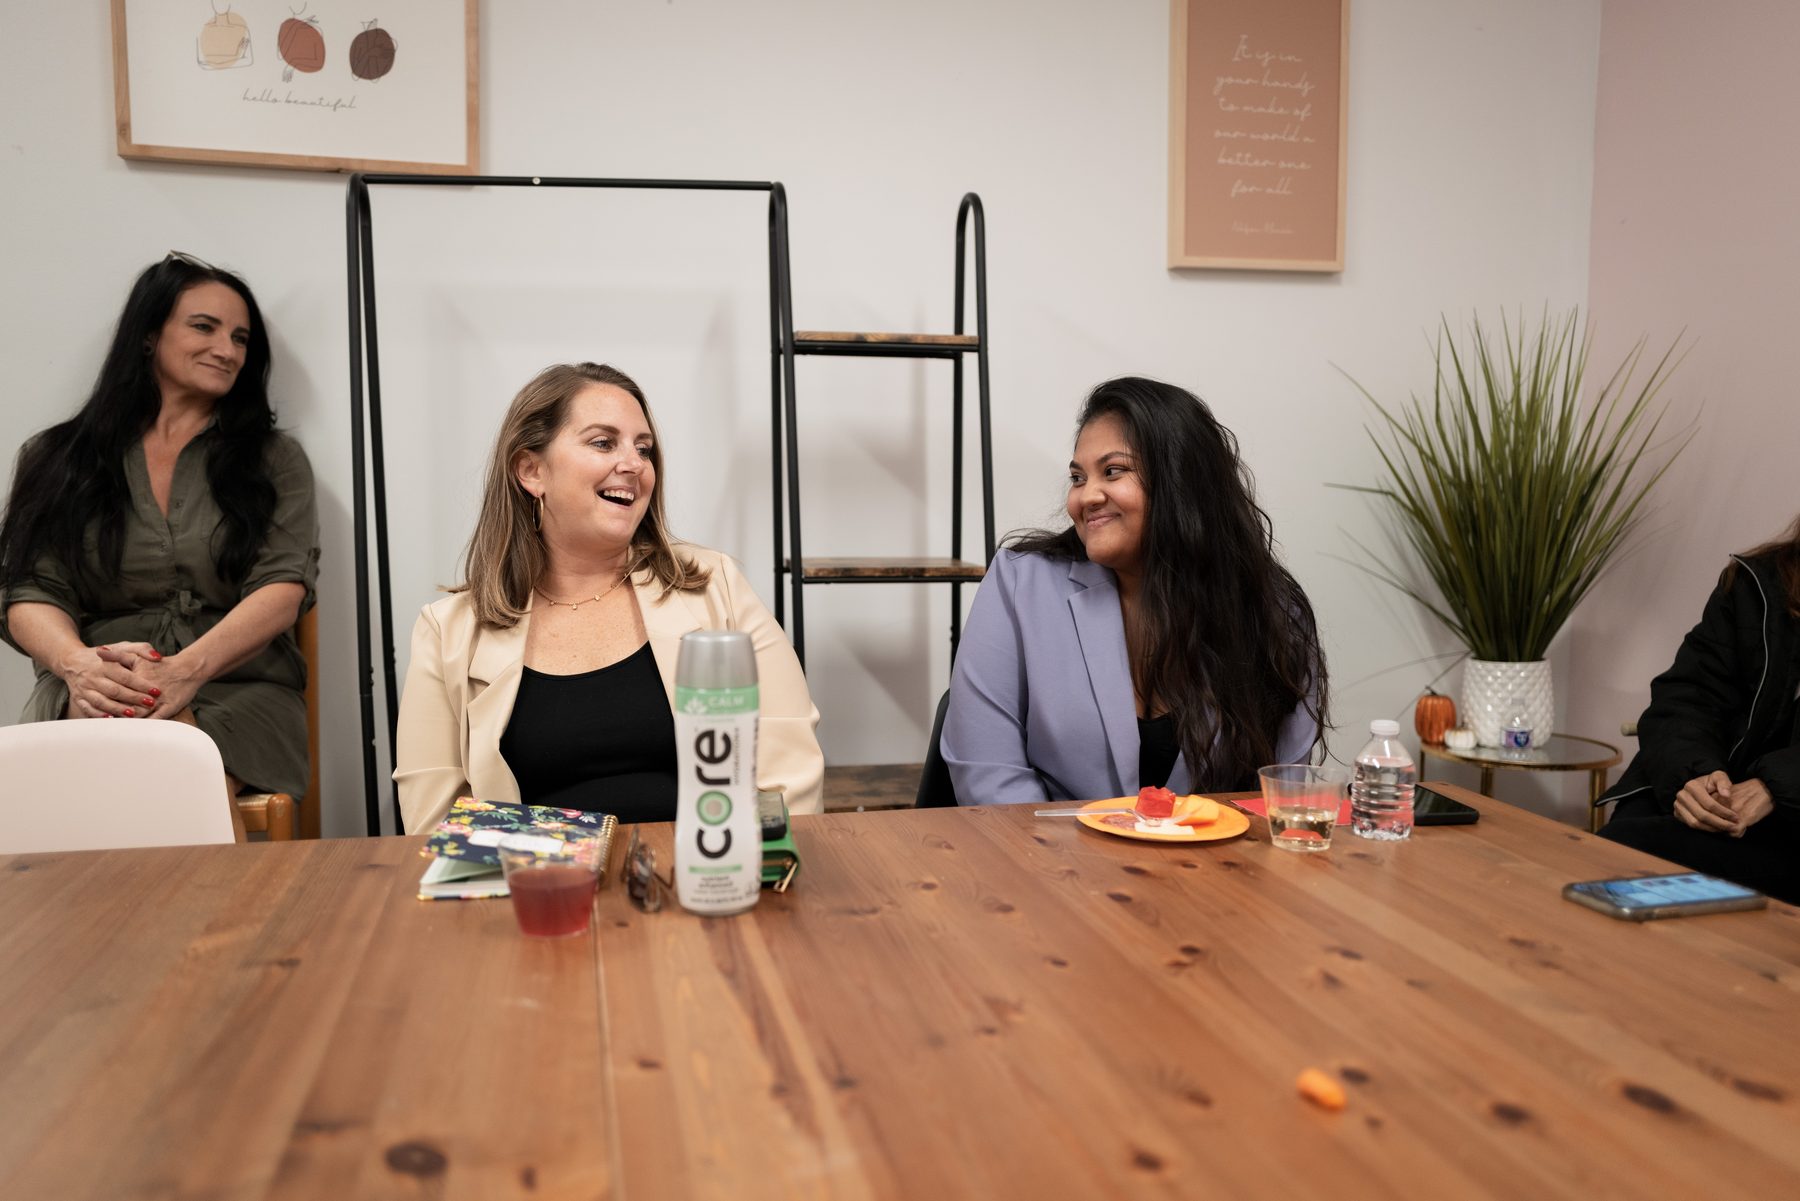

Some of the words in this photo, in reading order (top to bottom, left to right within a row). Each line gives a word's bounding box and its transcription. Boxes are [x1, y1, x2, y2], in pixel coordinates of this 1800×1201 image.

[1232, 34, 1252, 61] It
[1279, 53, 1302, 62] in
[1213, 76, 1259, 95] your
[1262, 69, 1315, 97] hands
[242, 88, 280, 103] hello
[284, 91, 356, 112] beautiful
[1219, 98, 1240, 112] to
[1242, 96, 1290, 114] make
[1293, 103, 1312, 121] of
[1214, 129, 1247, 140] our
[1249, 122, 1300, 142] world
[1217, 145, 1276, 166] better
[1279, 161, 1312, 169] one
[1231, 179, 1263, 198] for
[1265, 176, 1293, 194] all
[694, 728, 733, 860] core
